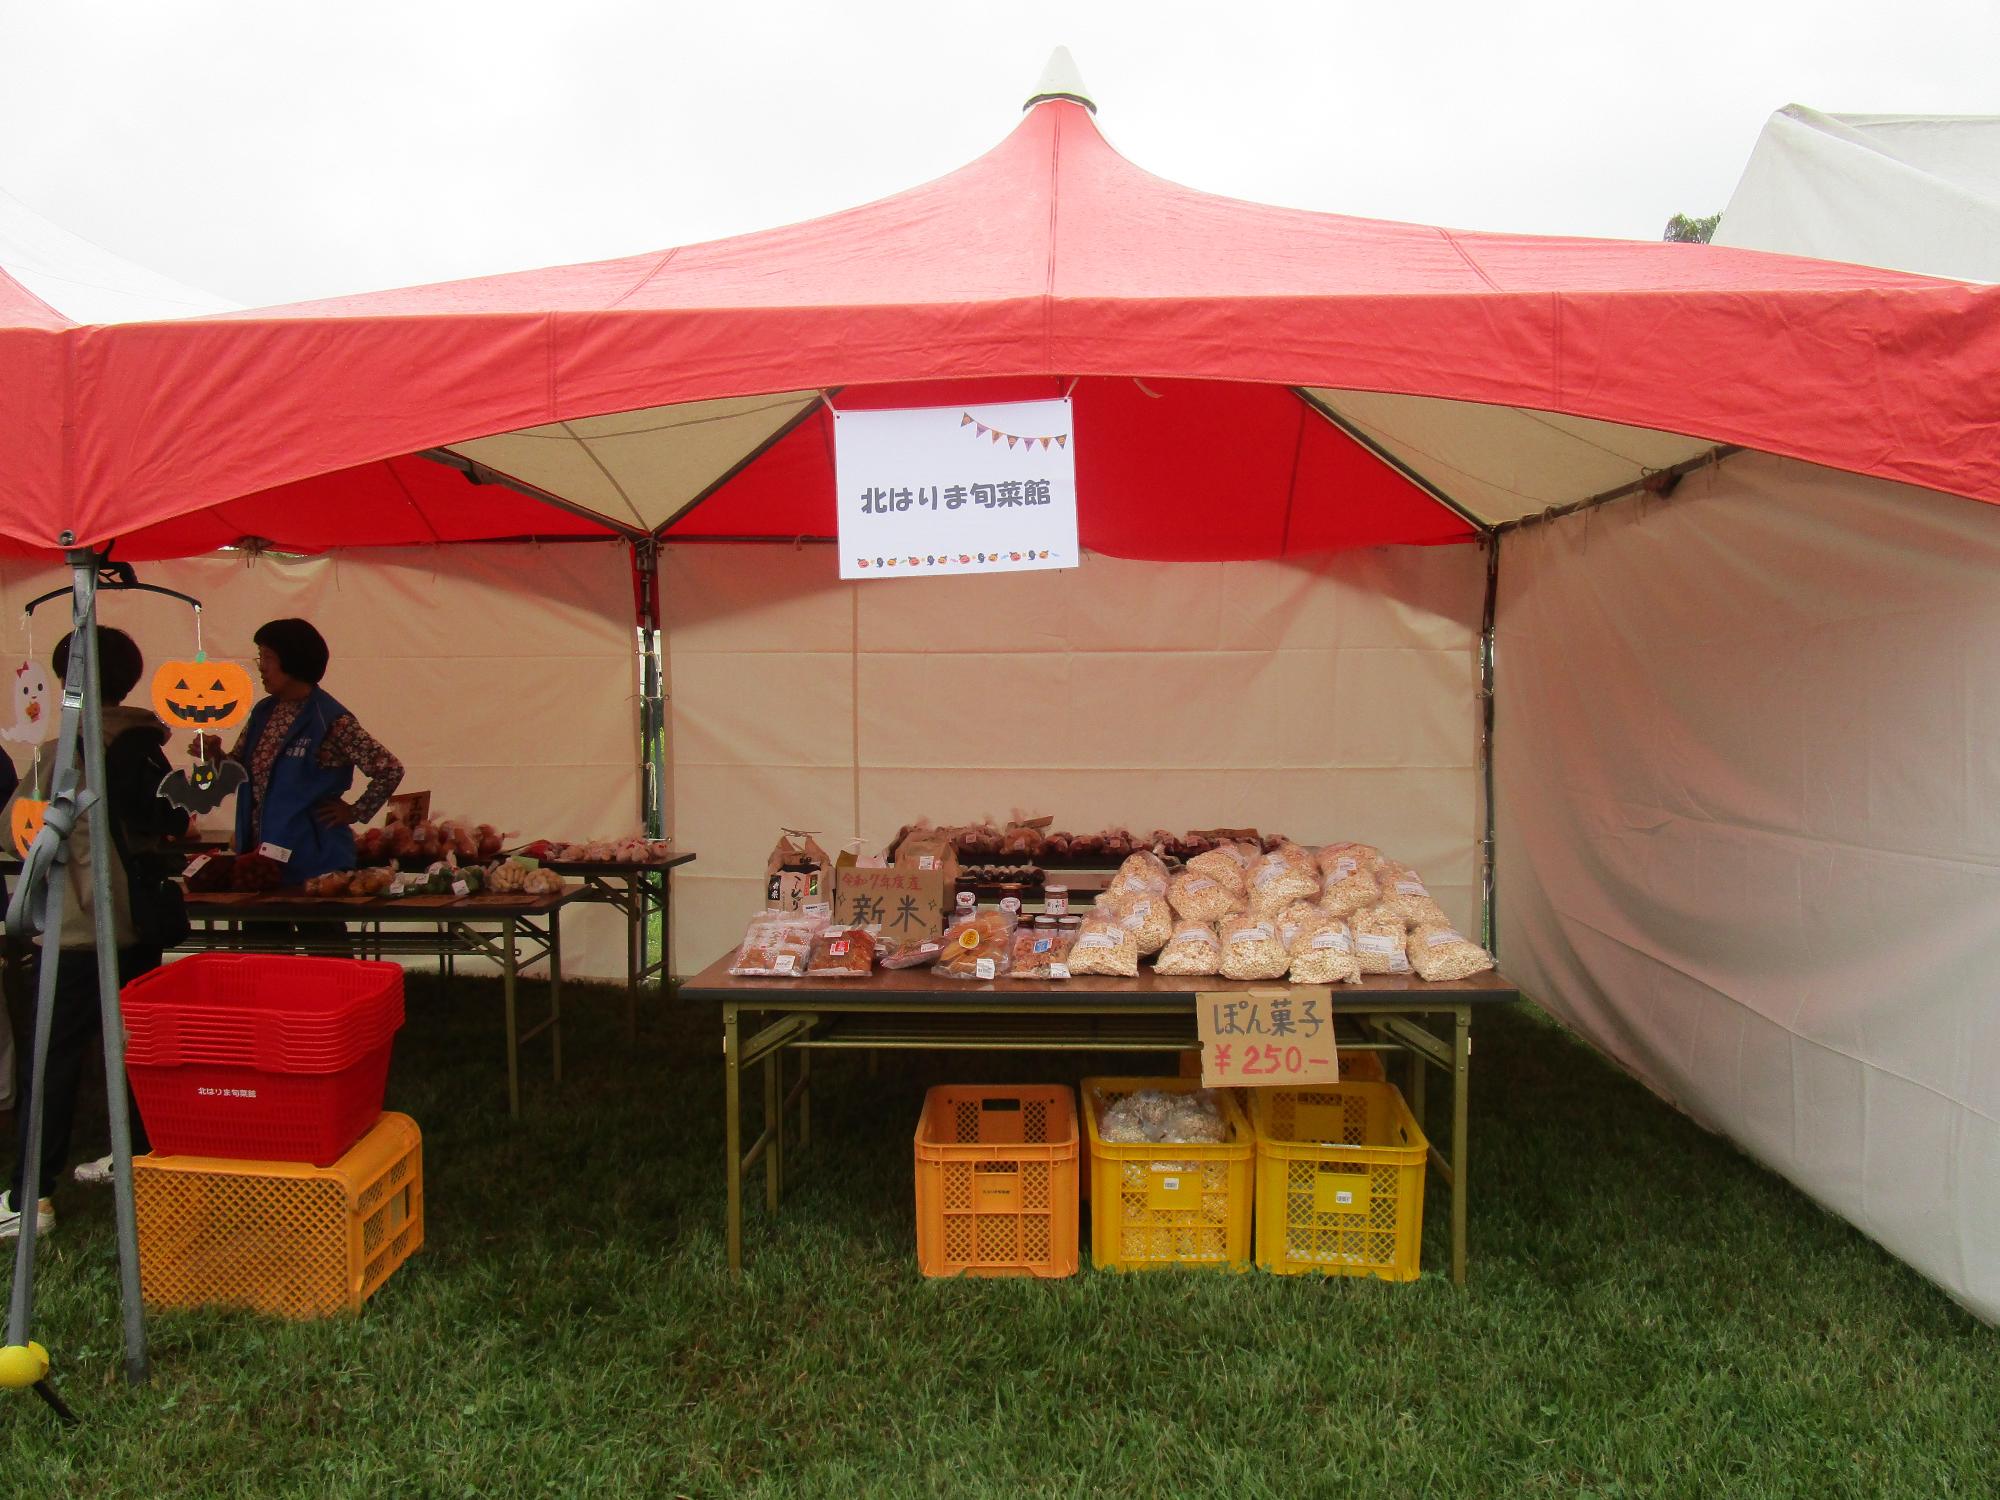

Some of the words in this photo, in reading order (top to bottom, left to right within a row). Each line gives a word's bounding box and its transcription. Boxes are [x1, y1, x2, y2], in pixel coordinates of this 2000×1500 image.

[860, 478, 1051, 514] 北はりま旬菜館
[849, 893, 927, 933] 新米
[1213, 998, 1325, 1038] ぽん菓子
[197, 1087, 257, 1098] 北はりま旬菜館
